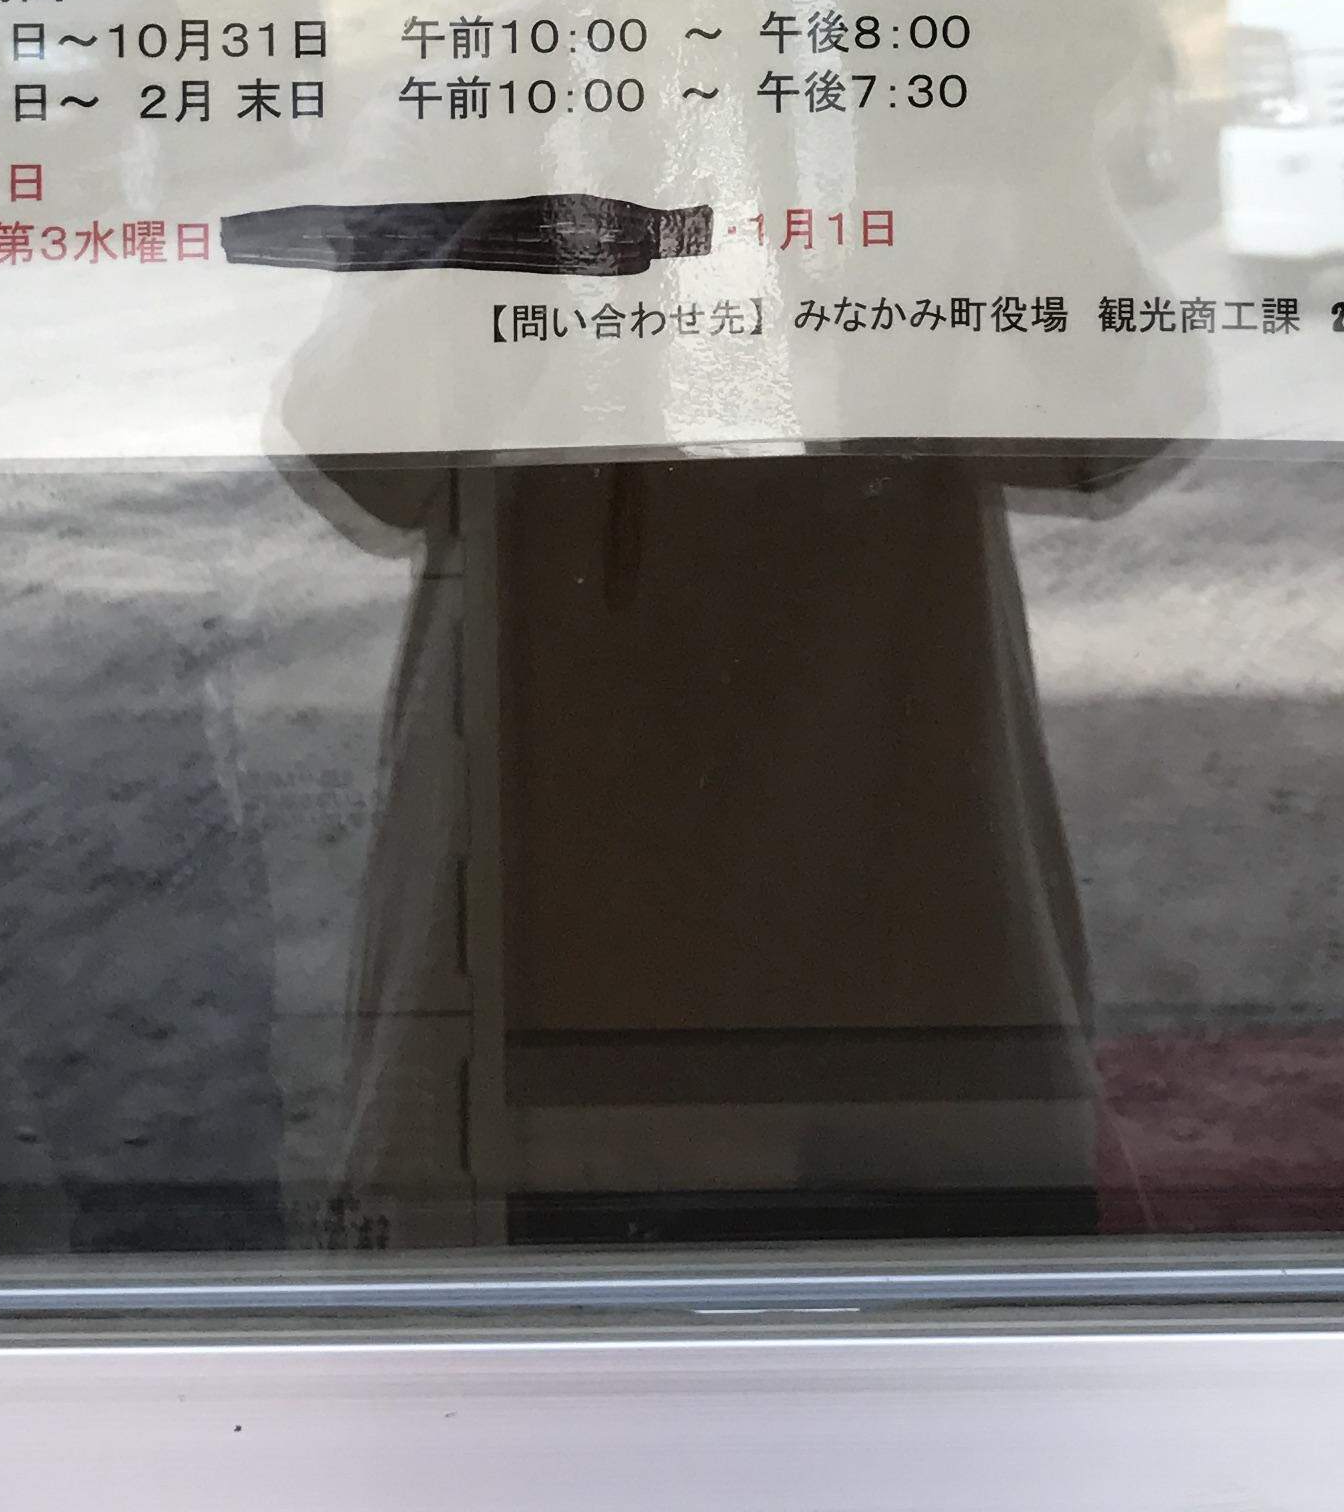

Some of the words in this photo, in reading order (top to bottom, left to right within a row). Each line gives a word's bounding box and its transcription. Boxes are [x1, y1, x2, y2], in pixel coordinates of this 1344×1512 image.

[400, 13, 649, 58] 午前10:00
[758, 10, 972, 54] 午後8:00
[398, 76, 647, 120] 午前10:00
[756, 70, 969, 113] 午後7:30
[490, 297, 765, 343] 【問い合わせ先】
[793, 295, 1069, 336] みなかみ町役場
[1097, 296, 1302, 337] 観光商工課
